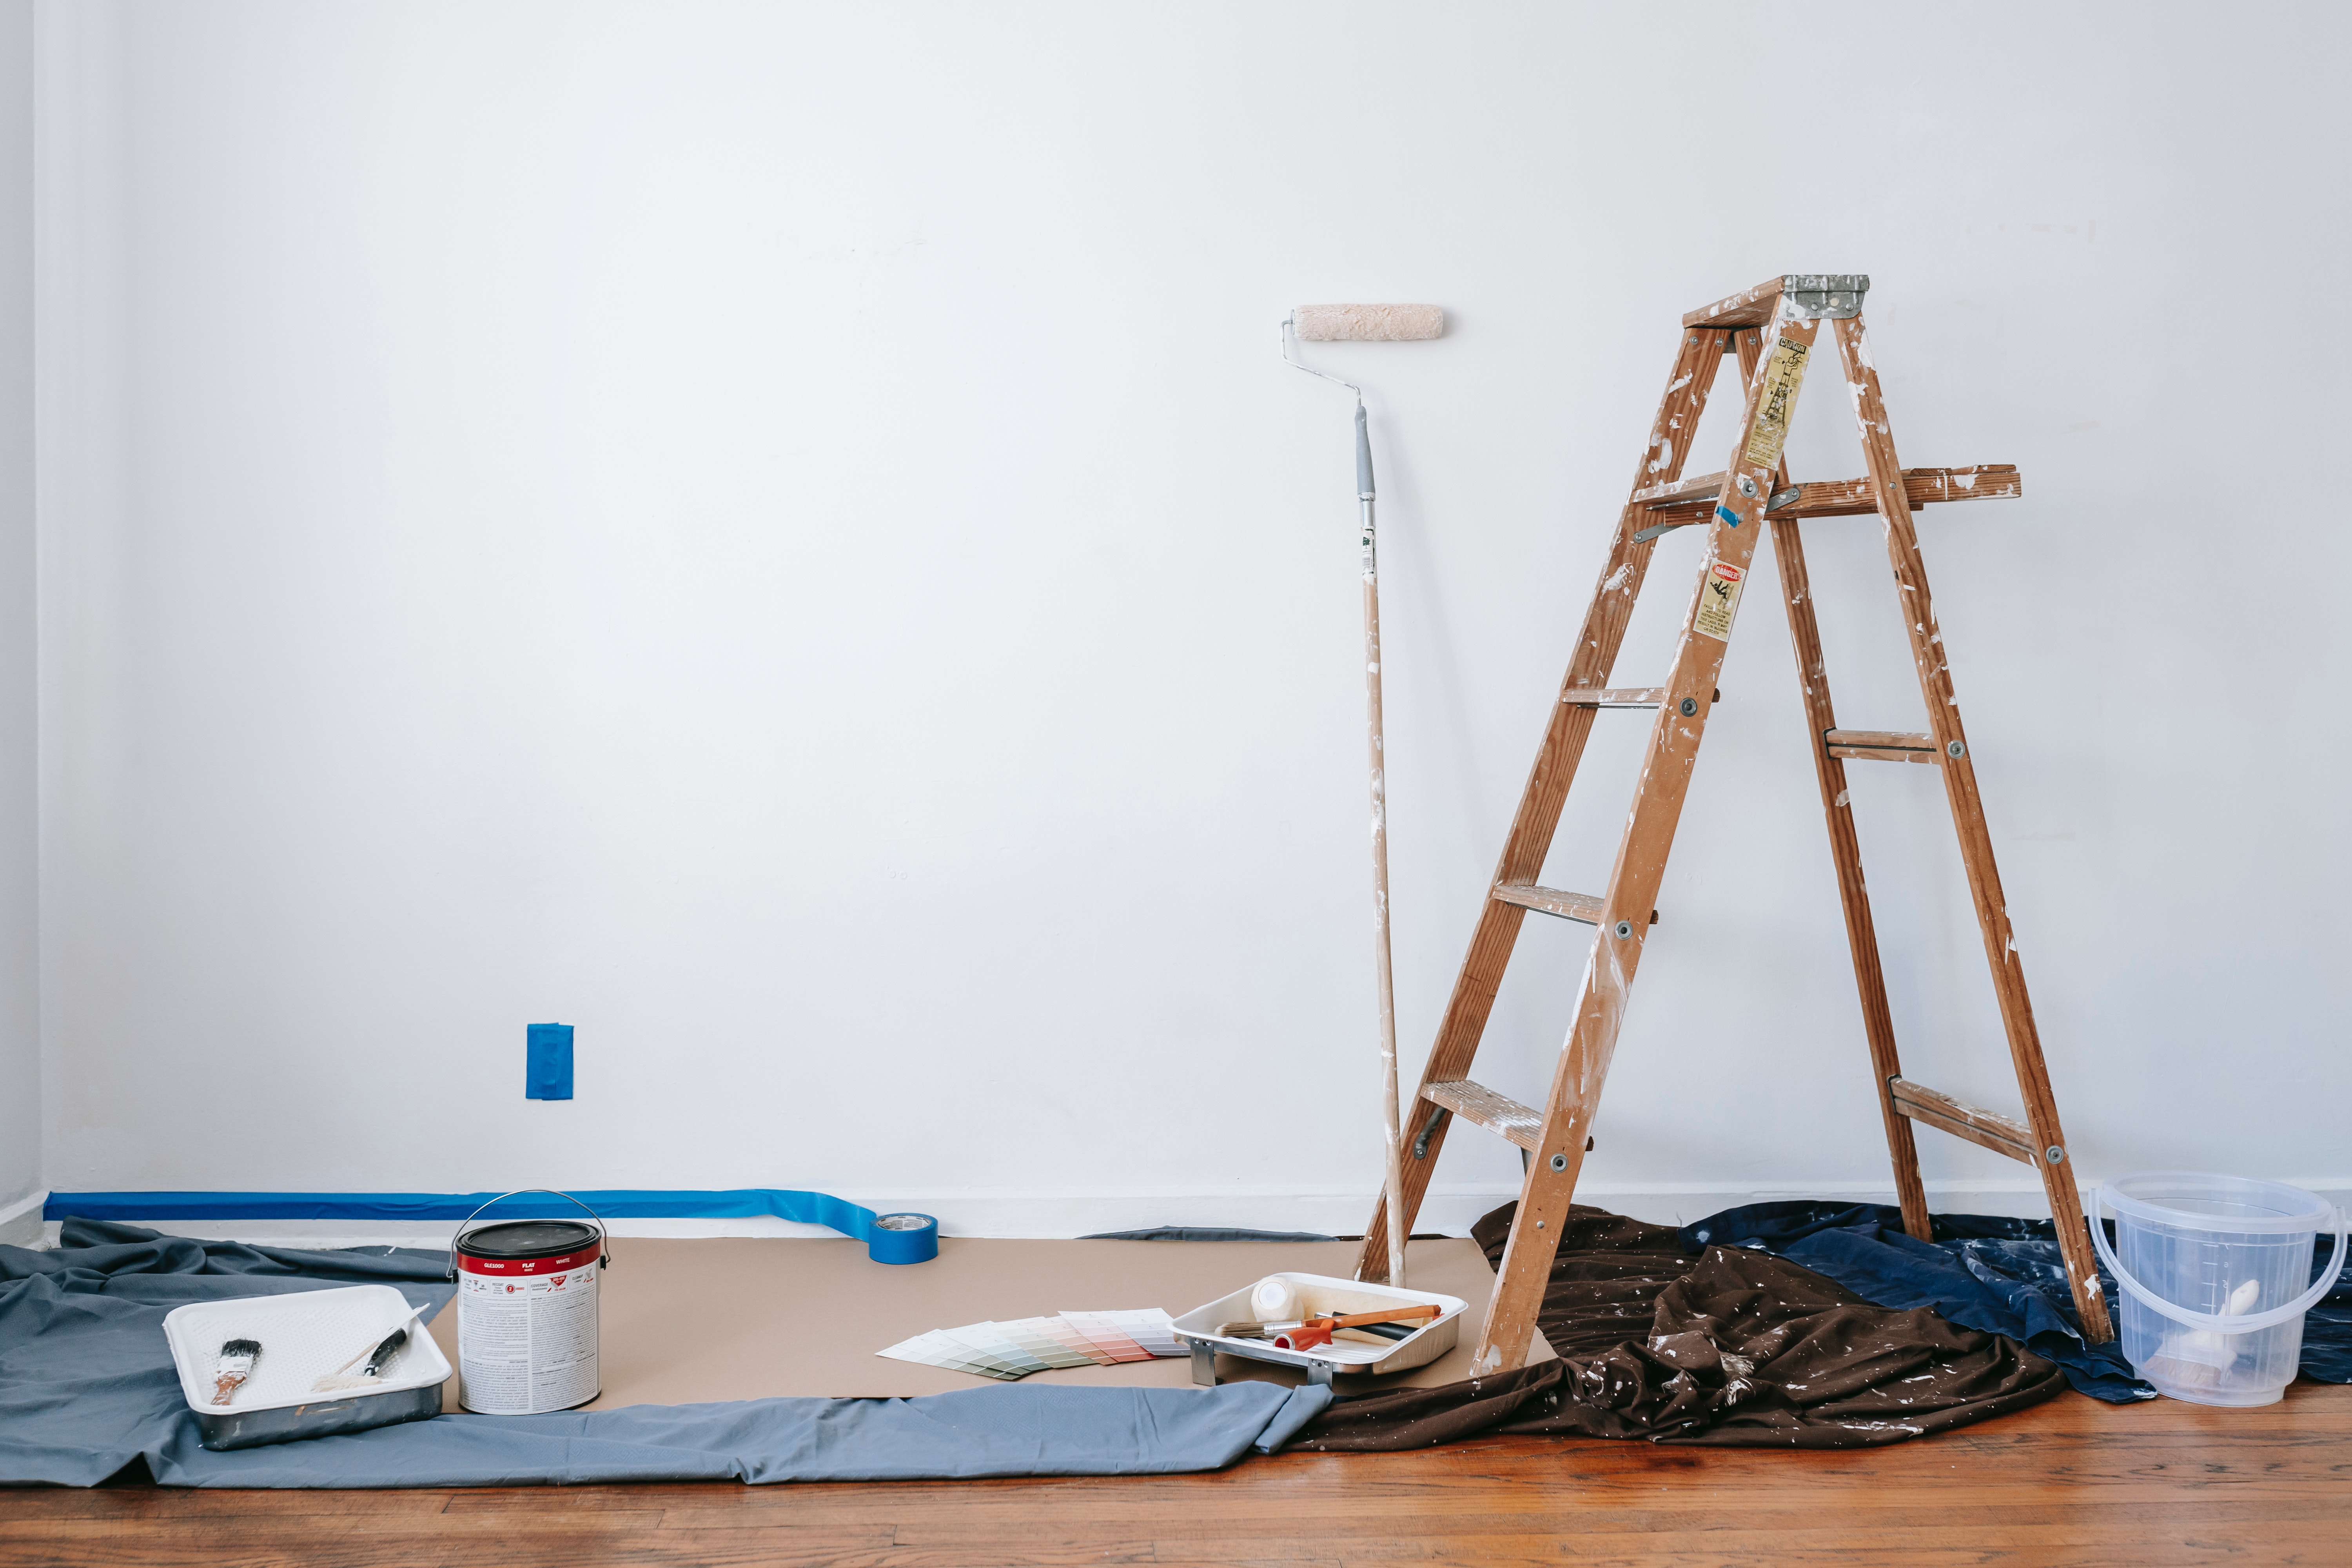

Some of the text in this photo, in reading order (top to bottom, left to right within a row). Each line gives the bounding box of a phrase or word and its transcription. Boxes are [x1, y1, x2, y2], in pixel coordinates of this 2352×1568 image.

[1780, 338, 1805, 352] CAUTION
[1715, 566, 1737, 580] DANGER
[1701, 612, 1723, 622] INSTRUCTIONS
